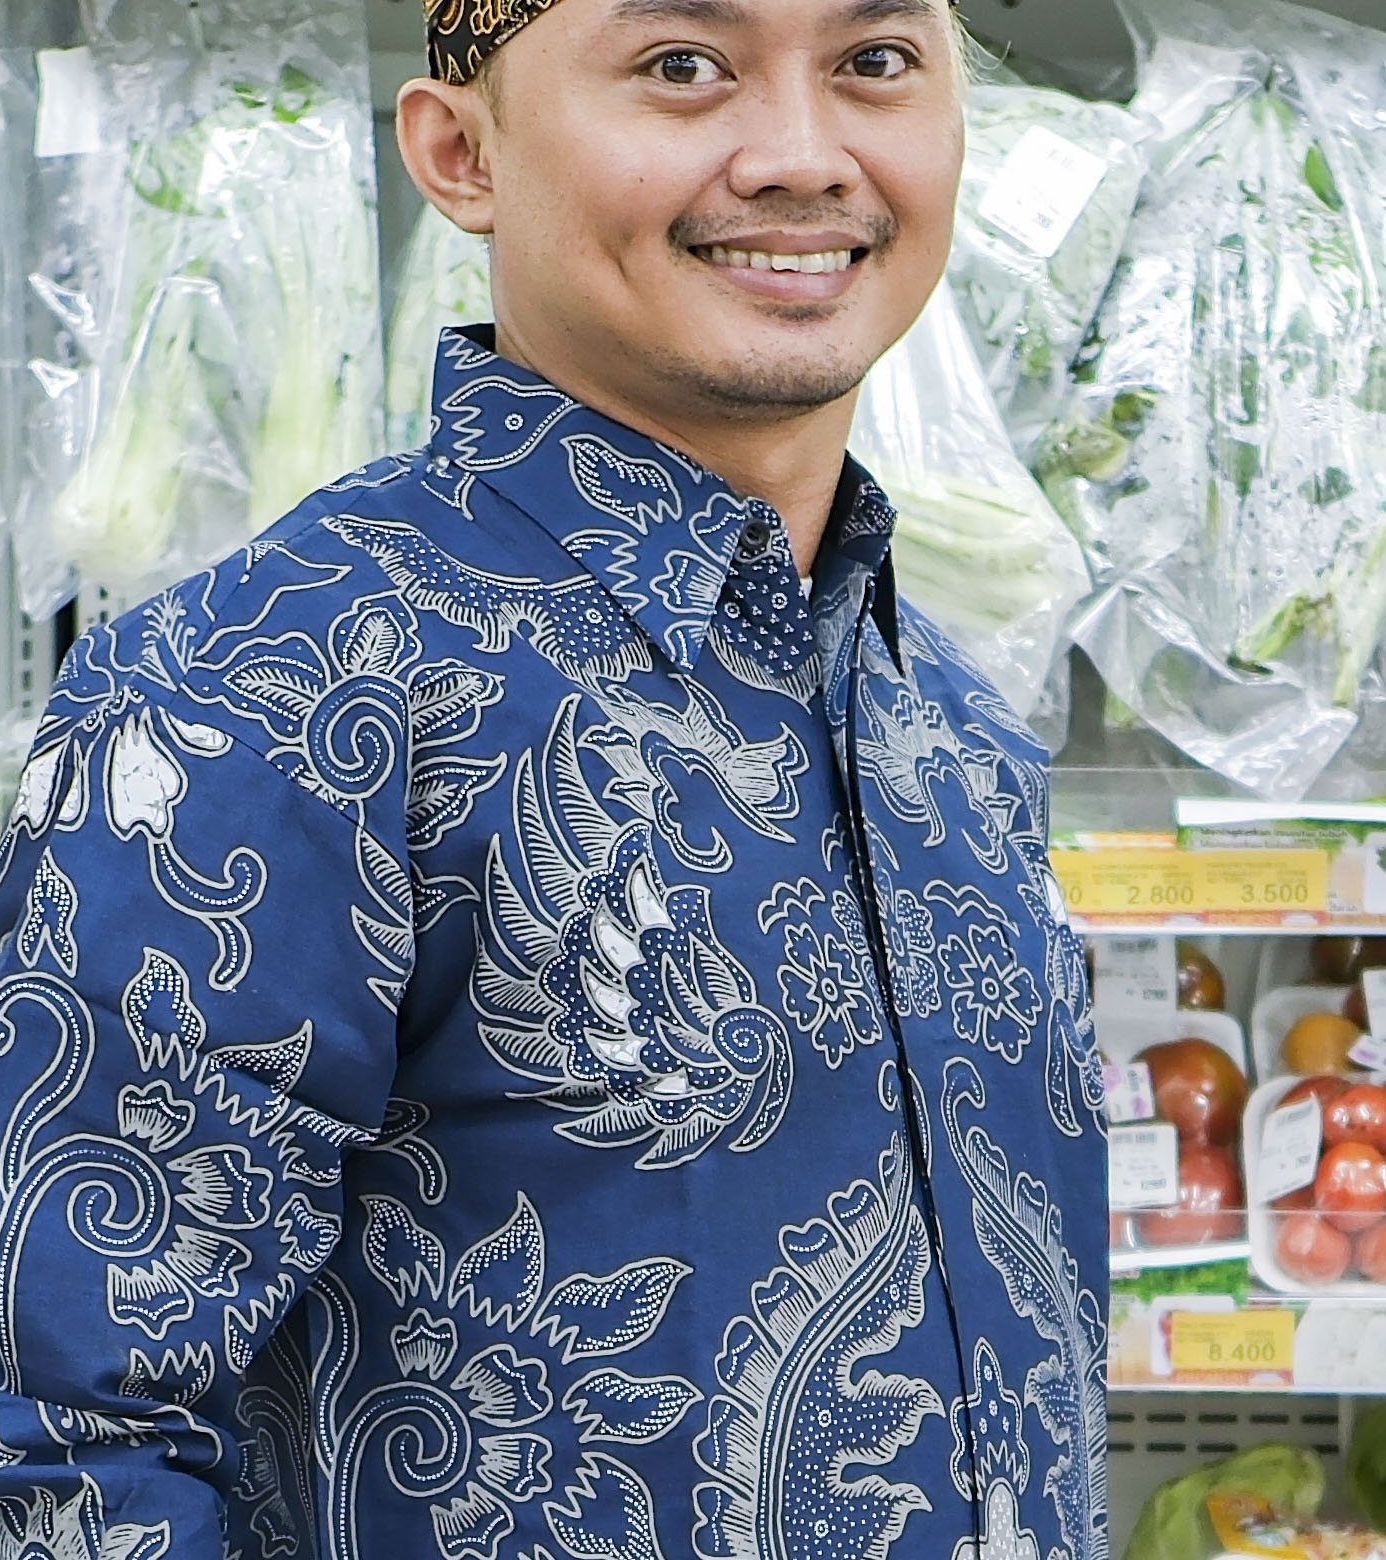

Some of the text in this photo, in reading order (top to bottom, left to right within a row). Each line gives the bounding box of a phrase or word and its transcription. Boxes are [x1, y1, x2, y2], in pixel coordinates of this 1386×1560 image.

[1127, 885, 1195, 905] 2.800
[1241, 884, 1309, 904] 3.500
[1207, 1344, 1276, 1362] 8.400
